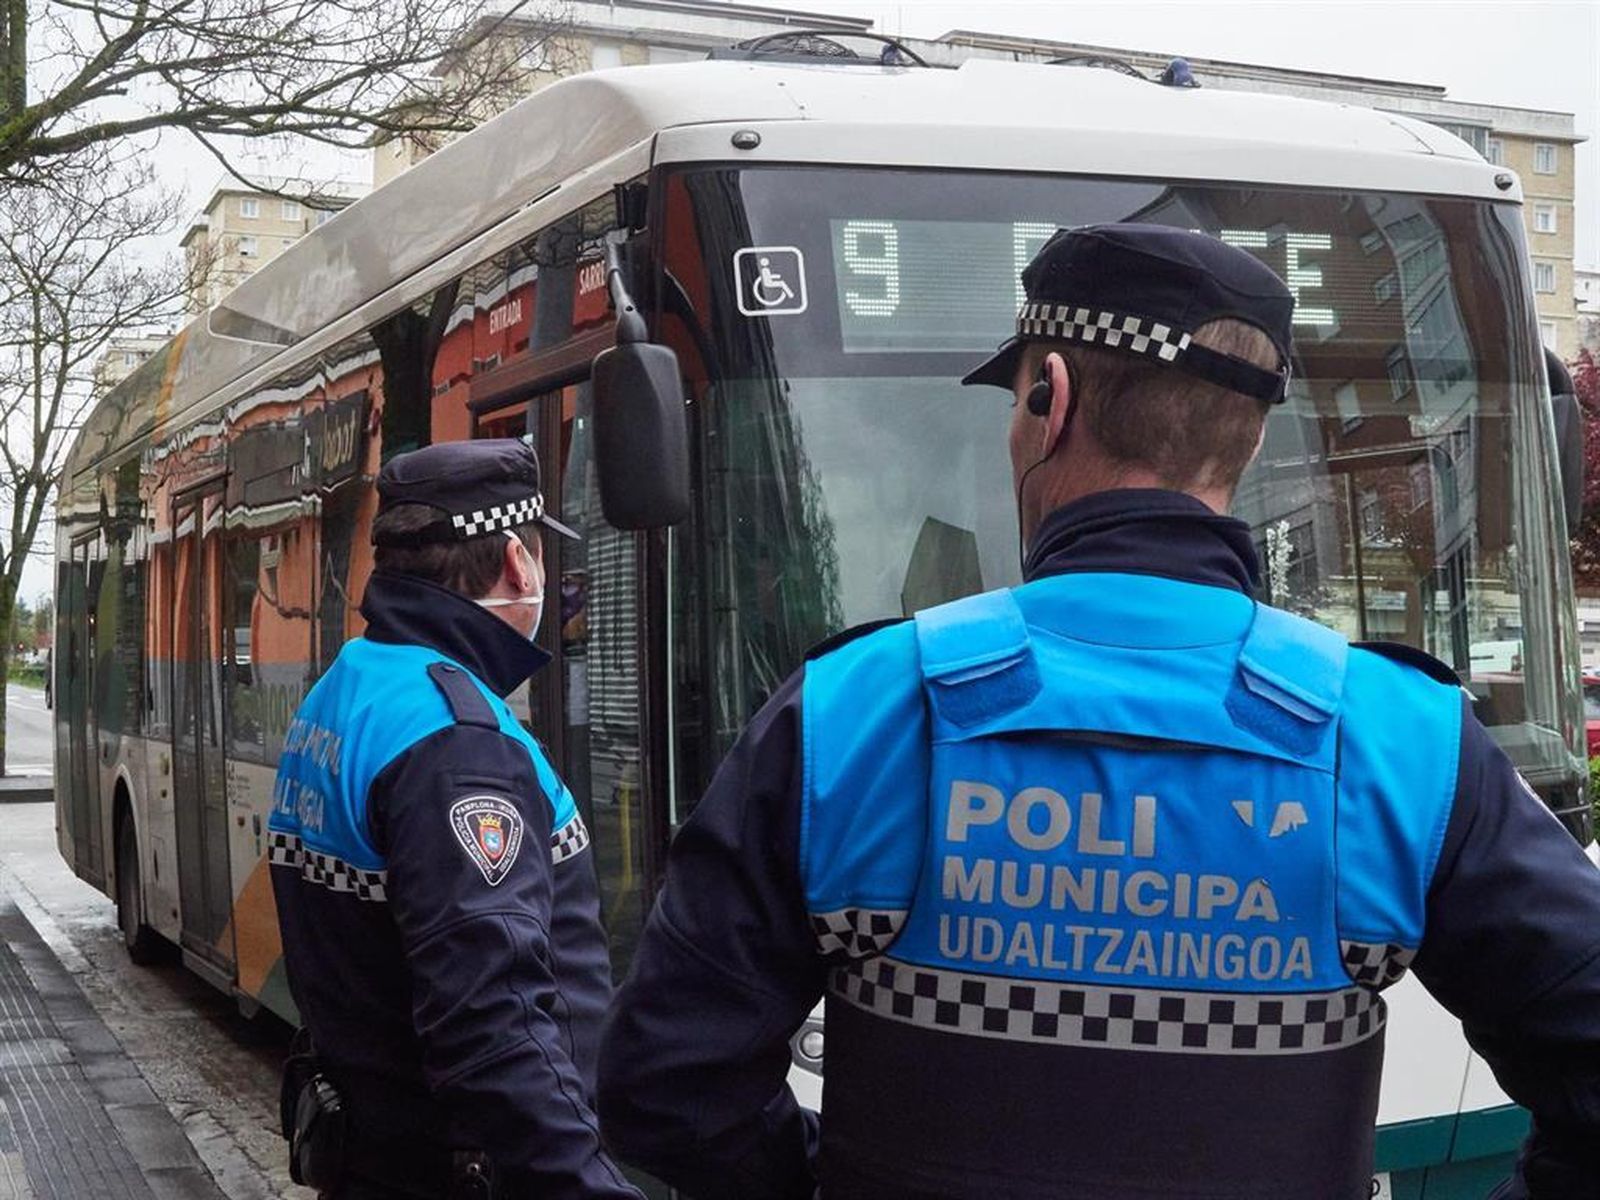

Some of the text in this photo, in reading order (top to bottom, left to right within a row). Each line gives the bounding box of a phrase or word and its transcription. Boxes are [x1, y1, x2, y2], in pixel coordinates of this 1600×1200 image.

[579, 260, 605, 295] SARRE
[843, 221, 900, 317] 9
[489, 298, 523, 335] ENTRADA
[455, 801, 495, 815] PAMPLONA
[938, 914, 1313, 980] UDALTZAINGOA
